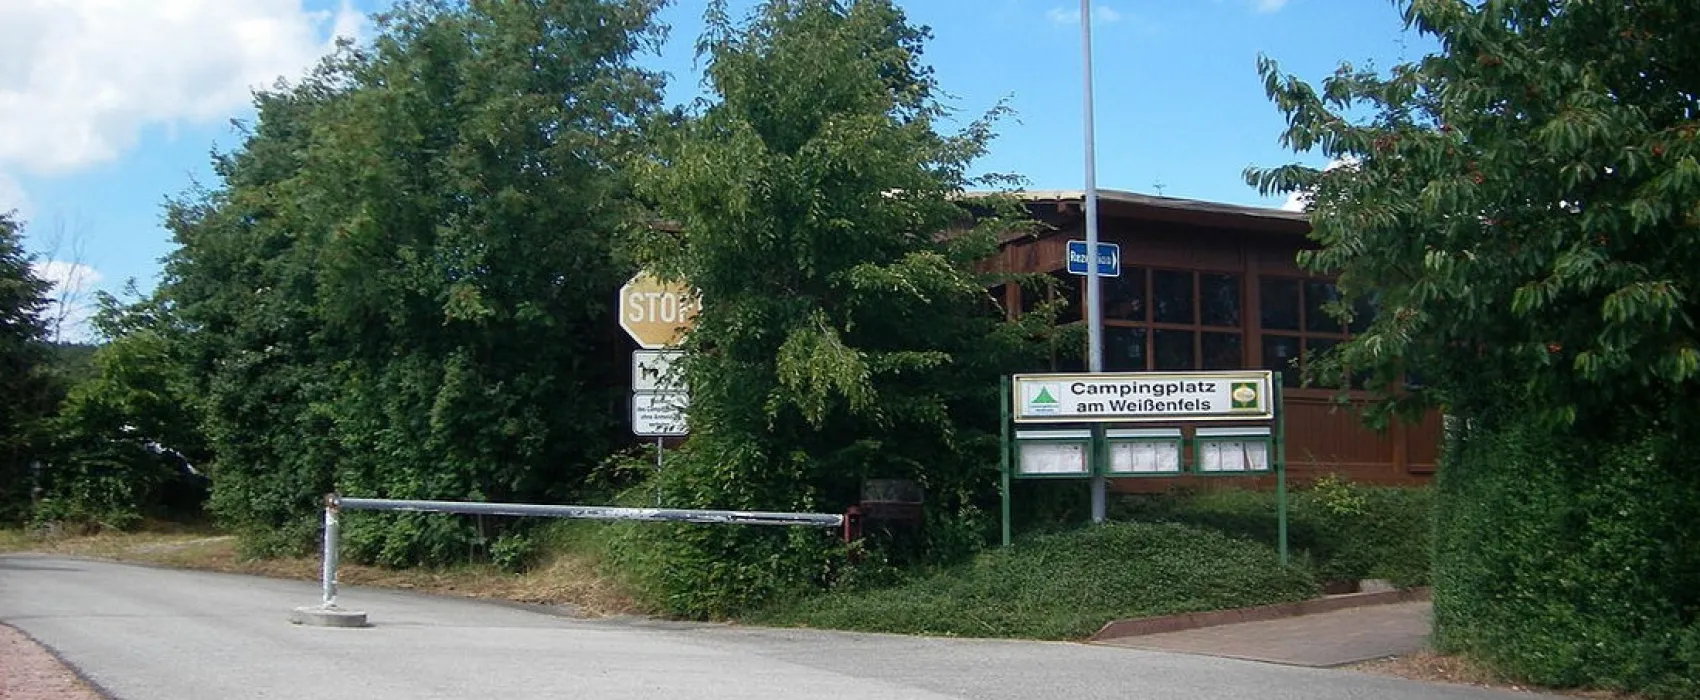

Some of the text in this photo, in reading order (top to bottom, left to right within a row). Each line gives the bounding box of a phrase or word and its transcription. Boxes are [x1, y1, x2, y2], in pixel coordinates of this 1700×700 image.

[1070, 381, 1216, 397] Campingplatz
[1076, 398, 1211, 412] am Weißenfels
